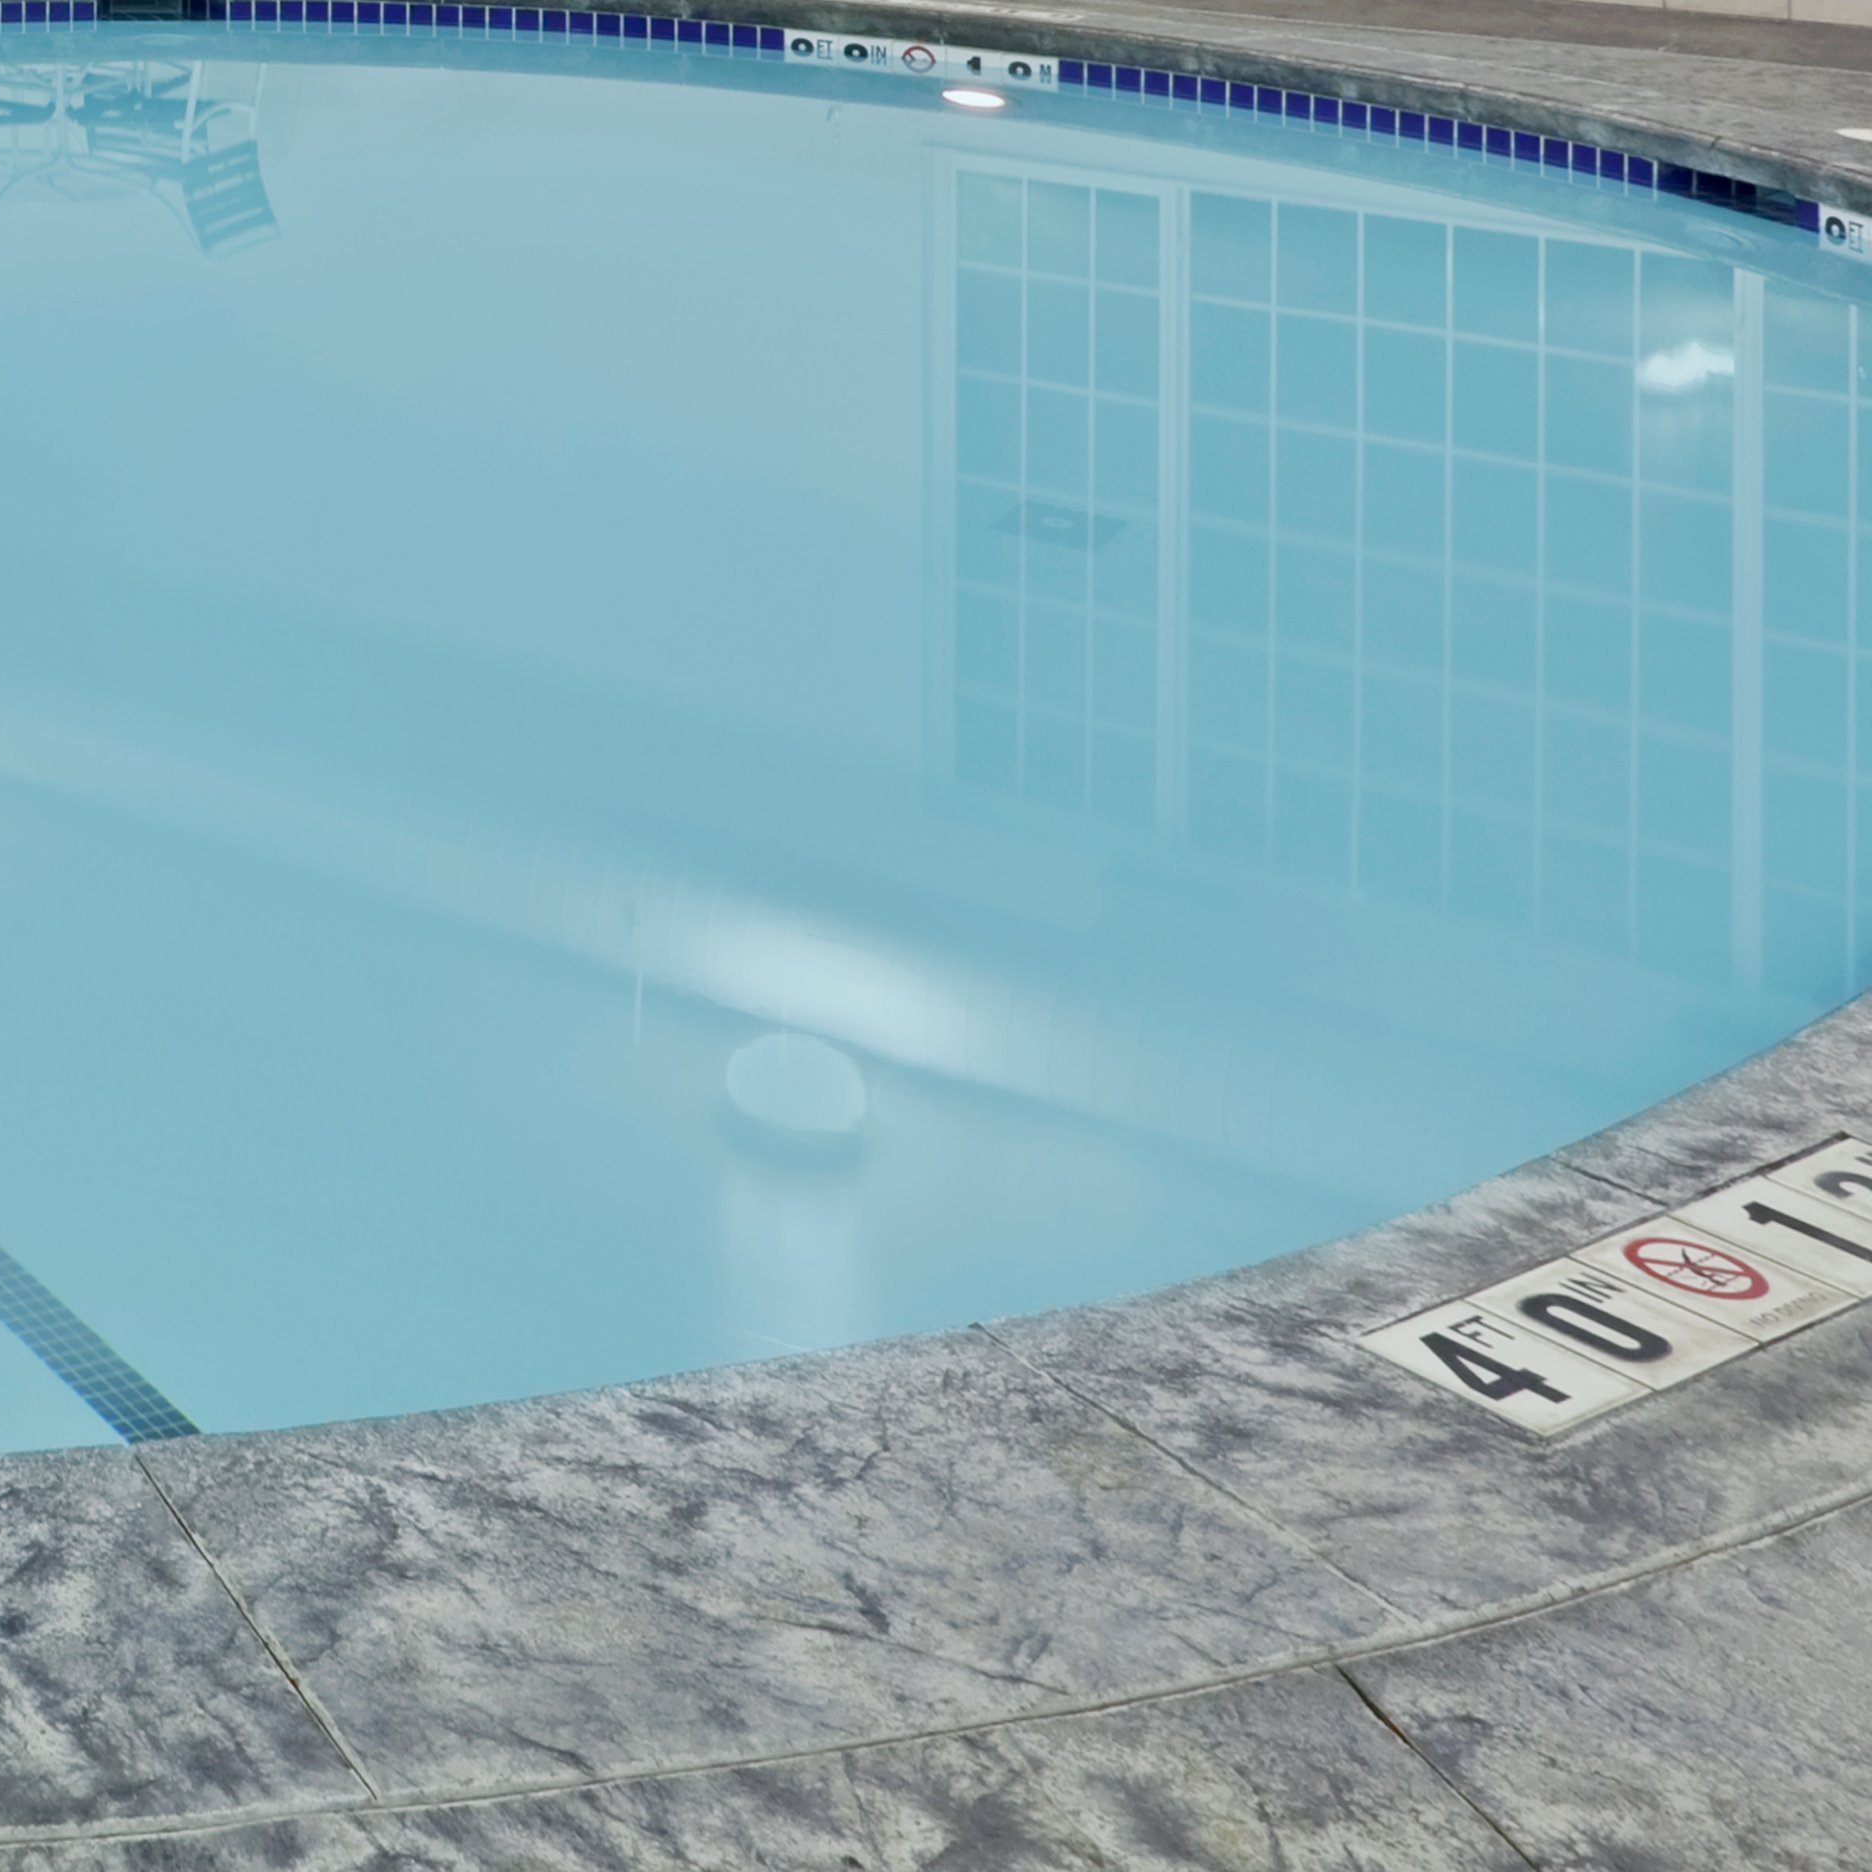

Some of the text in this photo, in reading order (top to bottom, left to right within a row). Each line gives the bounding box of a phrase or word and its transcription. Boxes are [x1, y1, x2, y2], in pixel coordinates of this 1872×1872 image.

[1559, 1273, 1627, 1303] IN
[1517, 1293, 1673, 1363] 0
[1749, 1291, 1828, 1328] NO DIVING
[1447, 1315, 1515, 1349] FT
[1419, 1332, 1571, 1403] 4
